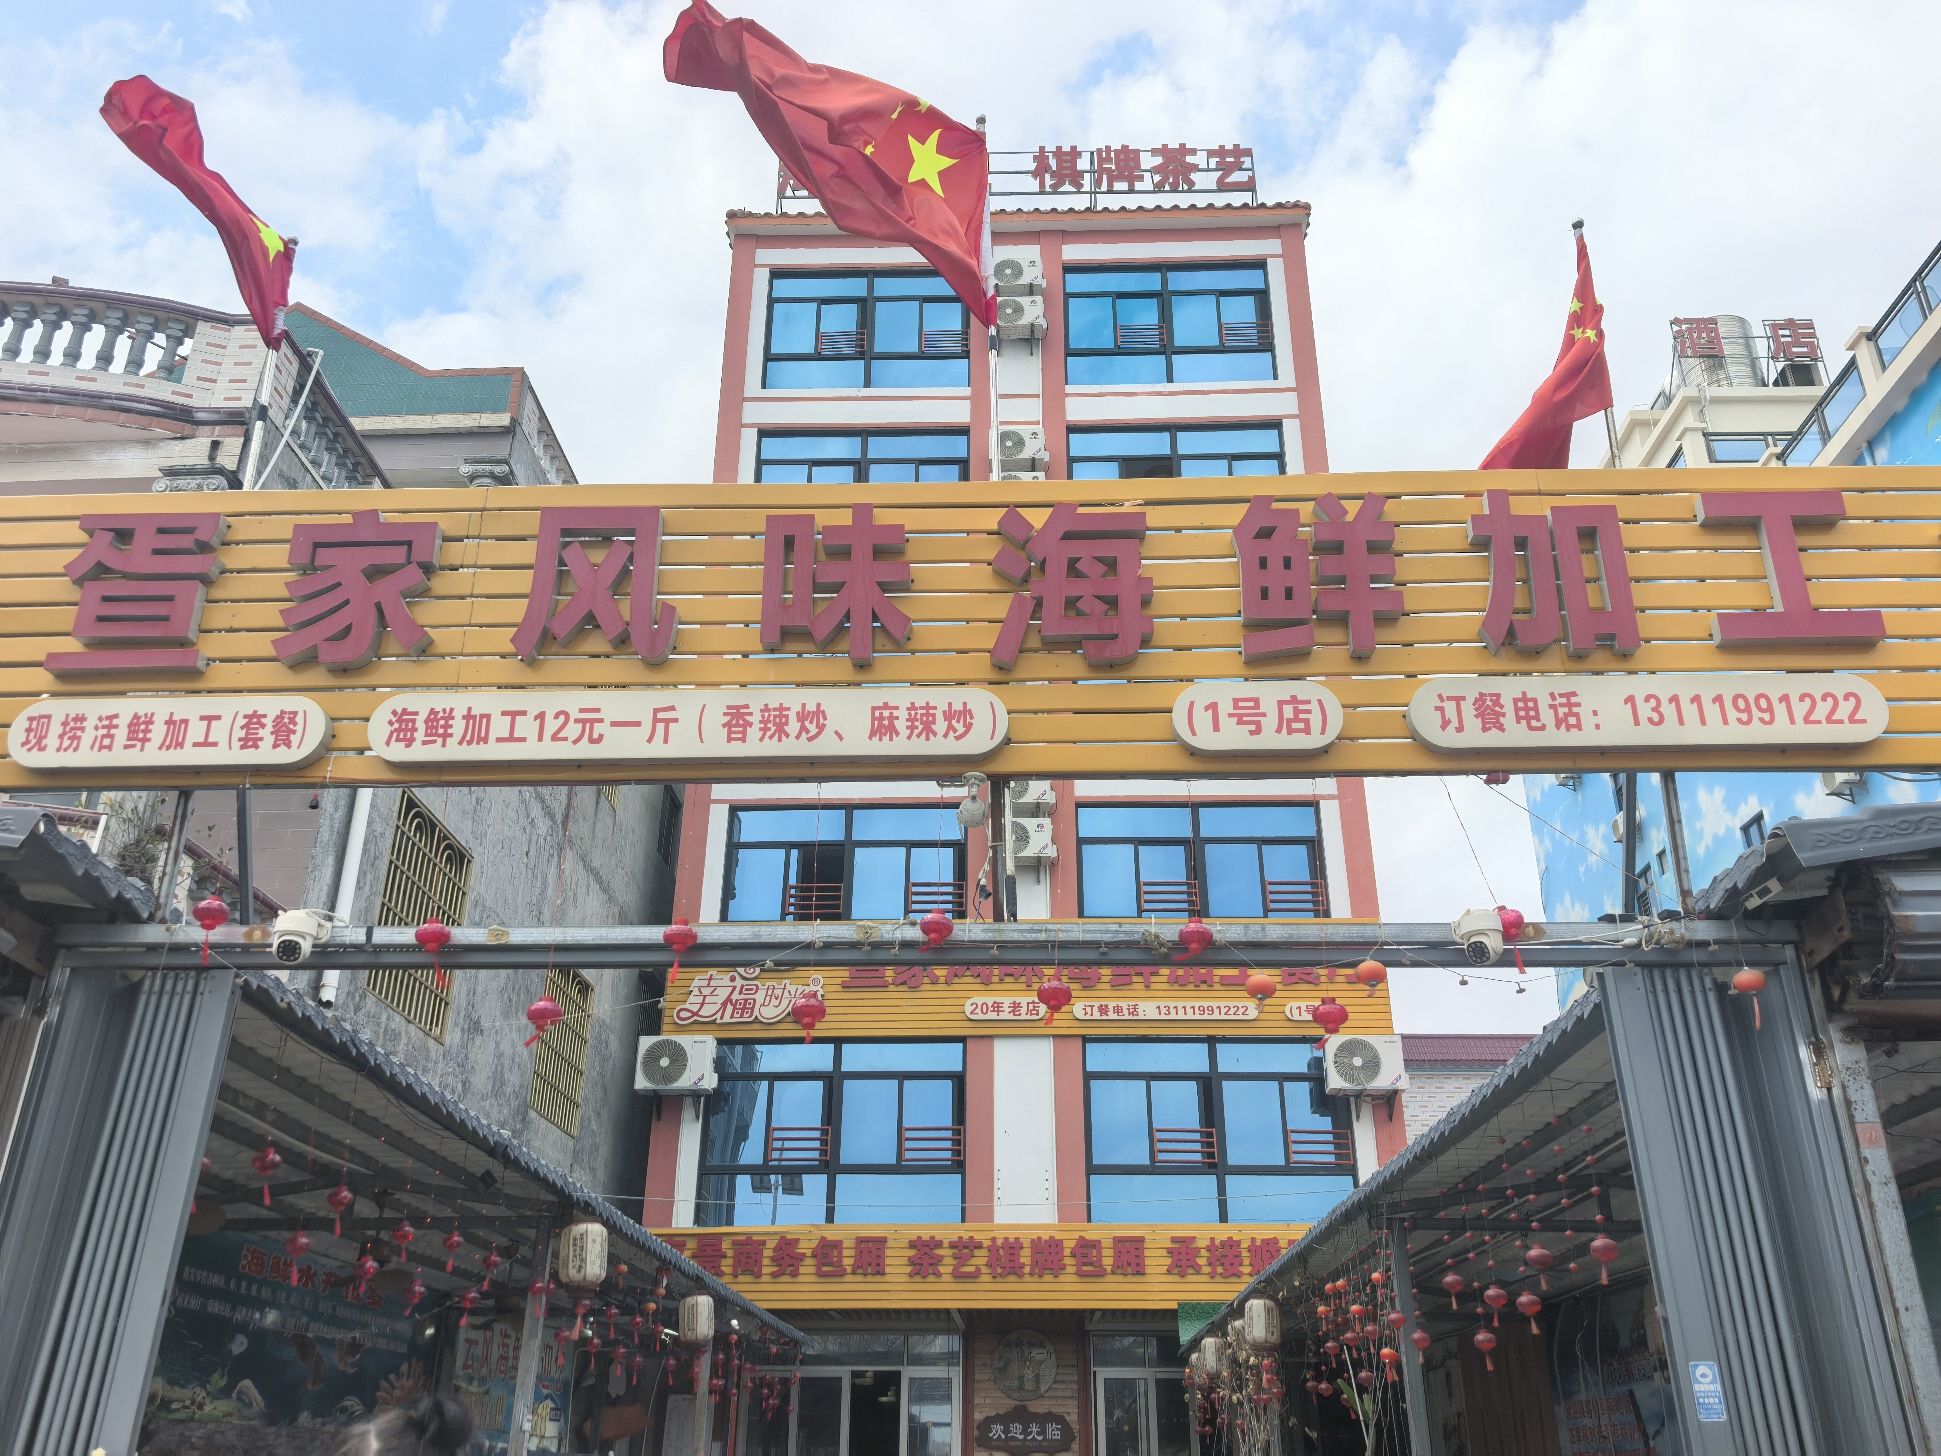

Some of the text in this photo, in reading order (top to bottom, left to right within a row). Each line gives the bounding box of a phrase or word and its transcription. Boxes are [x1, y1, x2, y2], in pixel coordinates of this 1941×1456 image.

[1031, 143, 1256, 192] 棋牌茶艺
[1672, 316, 1819, 361] 酒店
[43, 489, 1886, 676] 疍家风味海鲜加工
[20, 708, 308, 752] 现捞活鲜加工(套餐)
[1186, 694, 1328, 738] (1号店)
[969, 1000, 1041, 1018] 20年老店
[908, 1235, 1145, 1278] 茶艺棋牌包厢
[1166, 1235, 1300, 1279] 承接婚
[988, 1421, 1062, 1441] 欢迎光临
